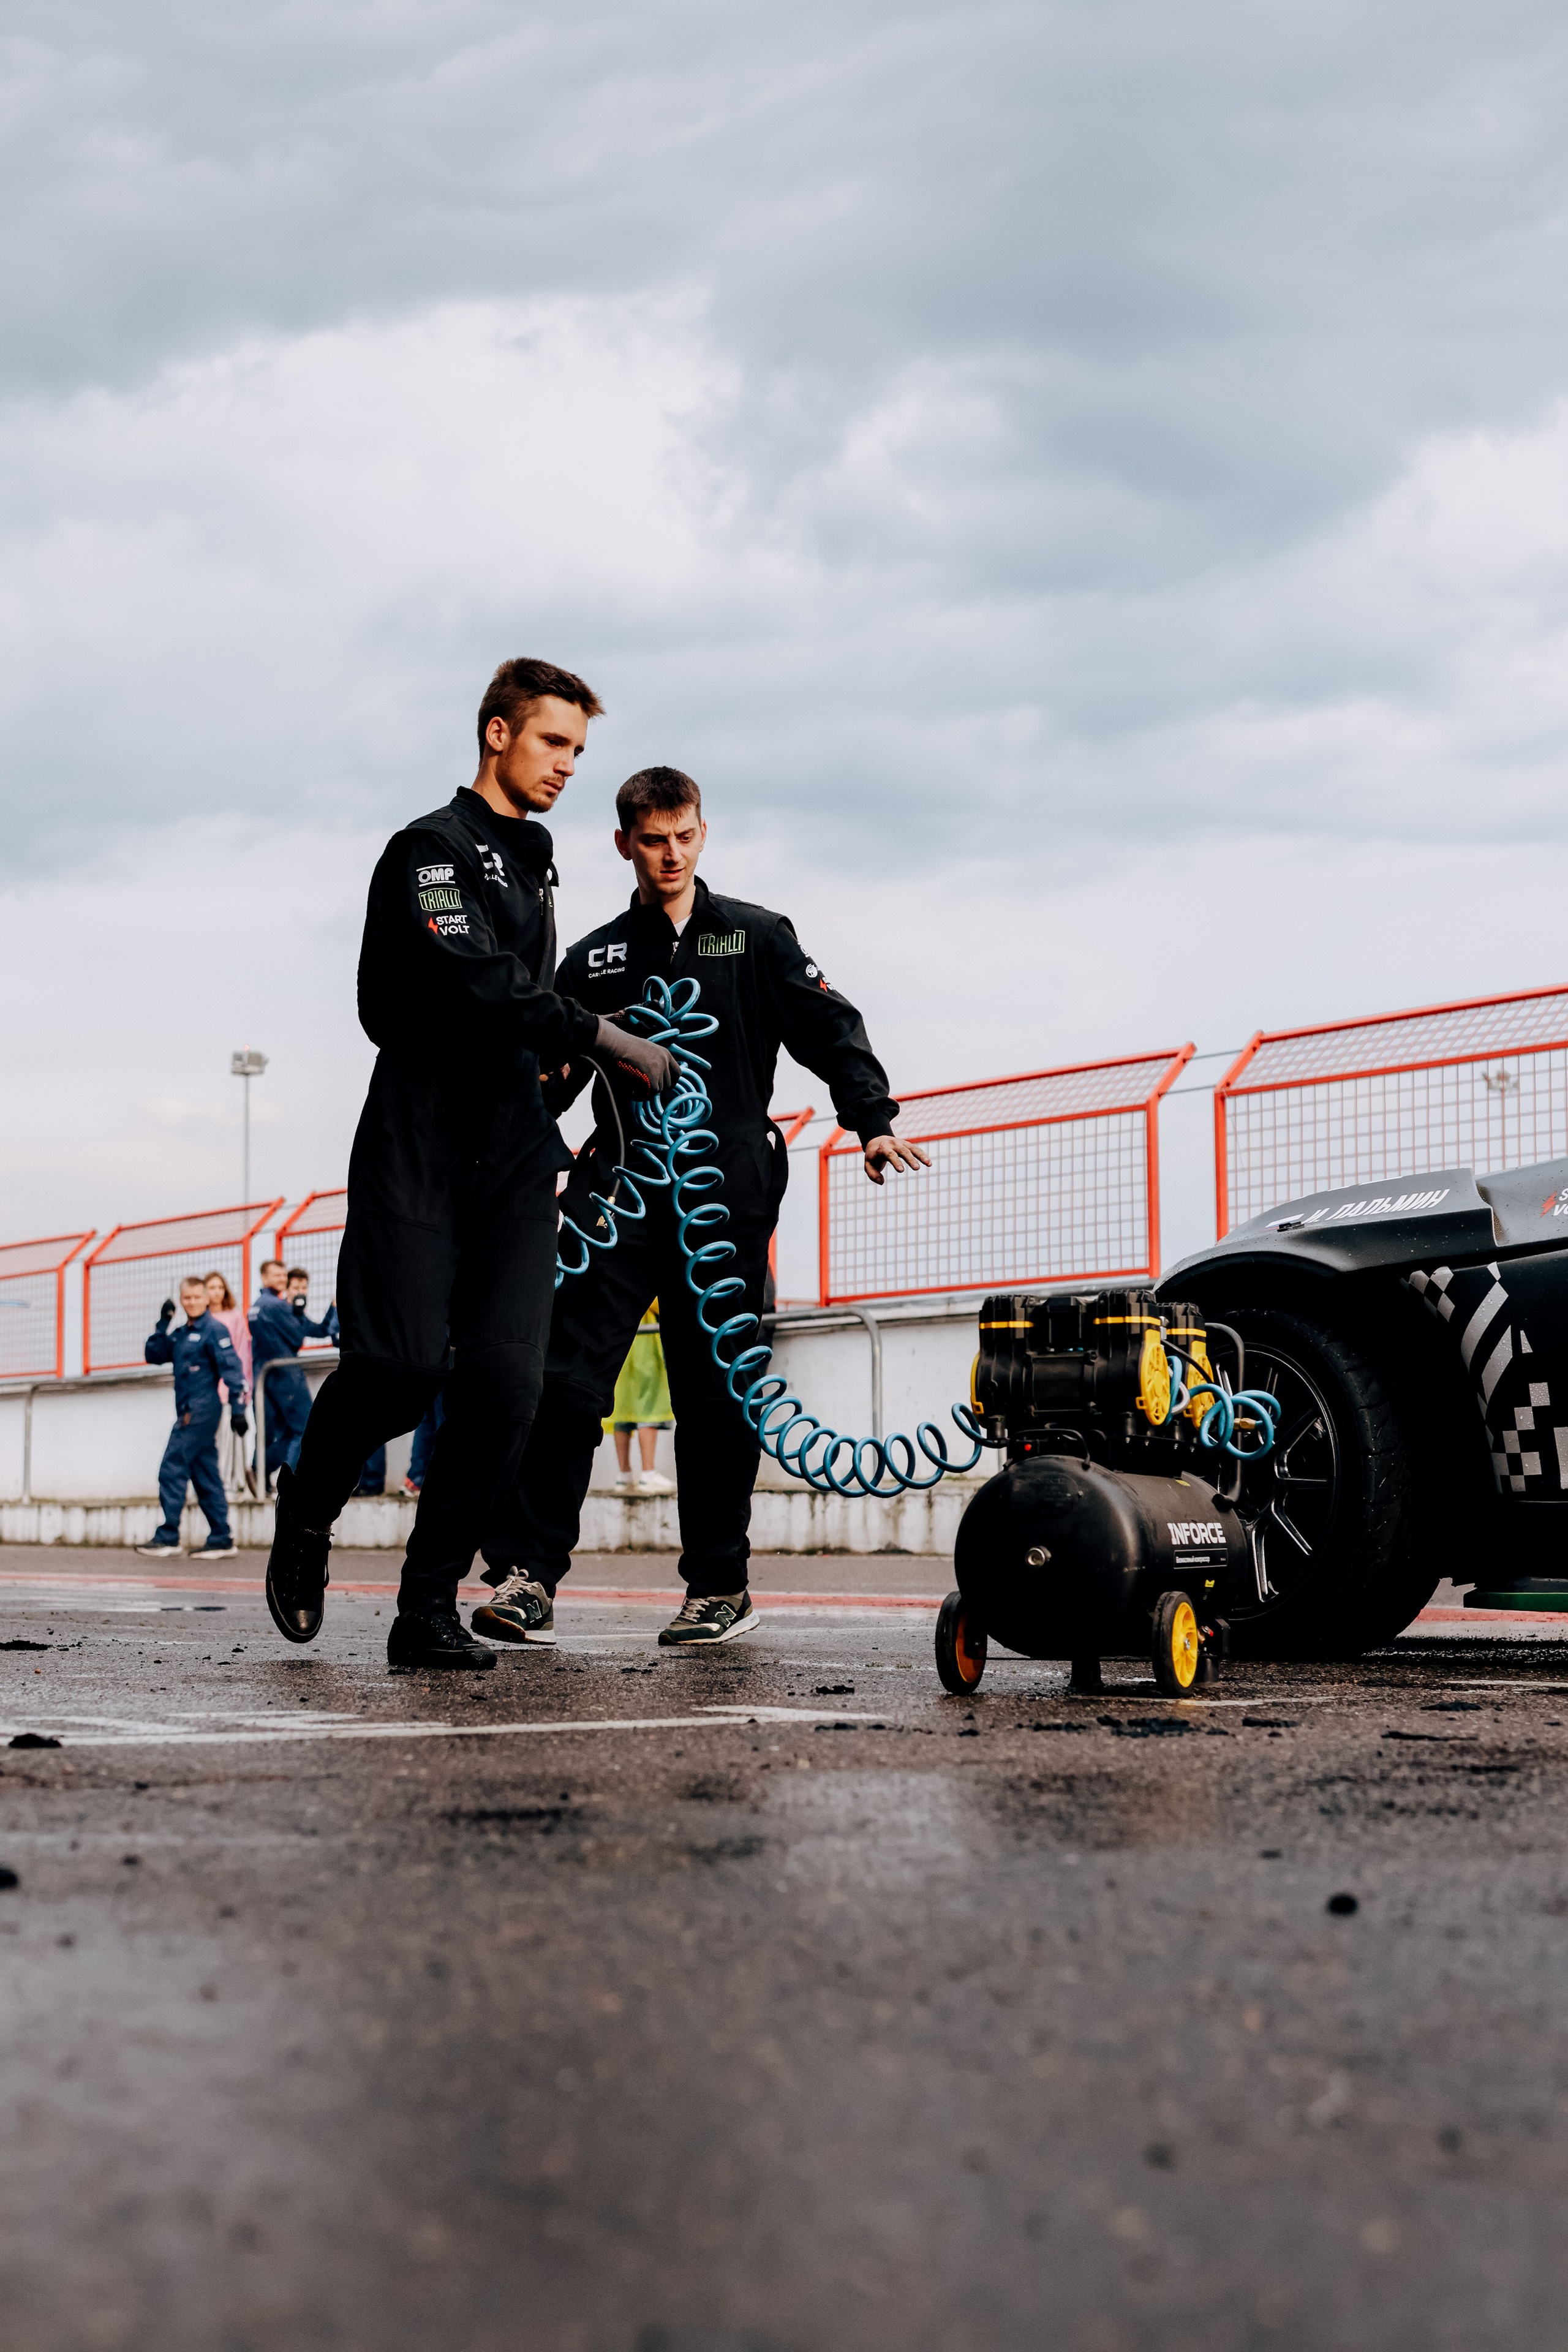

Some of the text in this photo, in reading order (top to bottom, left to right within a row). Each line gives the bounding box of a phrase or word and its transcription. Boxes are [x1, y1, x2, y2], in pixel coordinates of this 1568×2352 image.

[418, 867, 454, 883] OMP
[420, 889, 460, 910] TRIALLI
[435, 914, 468, 925] START
[439, 924, 470, 936] VOLT
[588, 942, 627, 968] CR
[1325, 1189, 1450, 1221] ПАЛЬМИН
[1167, 1522, 1227, 1545] INFORCE
